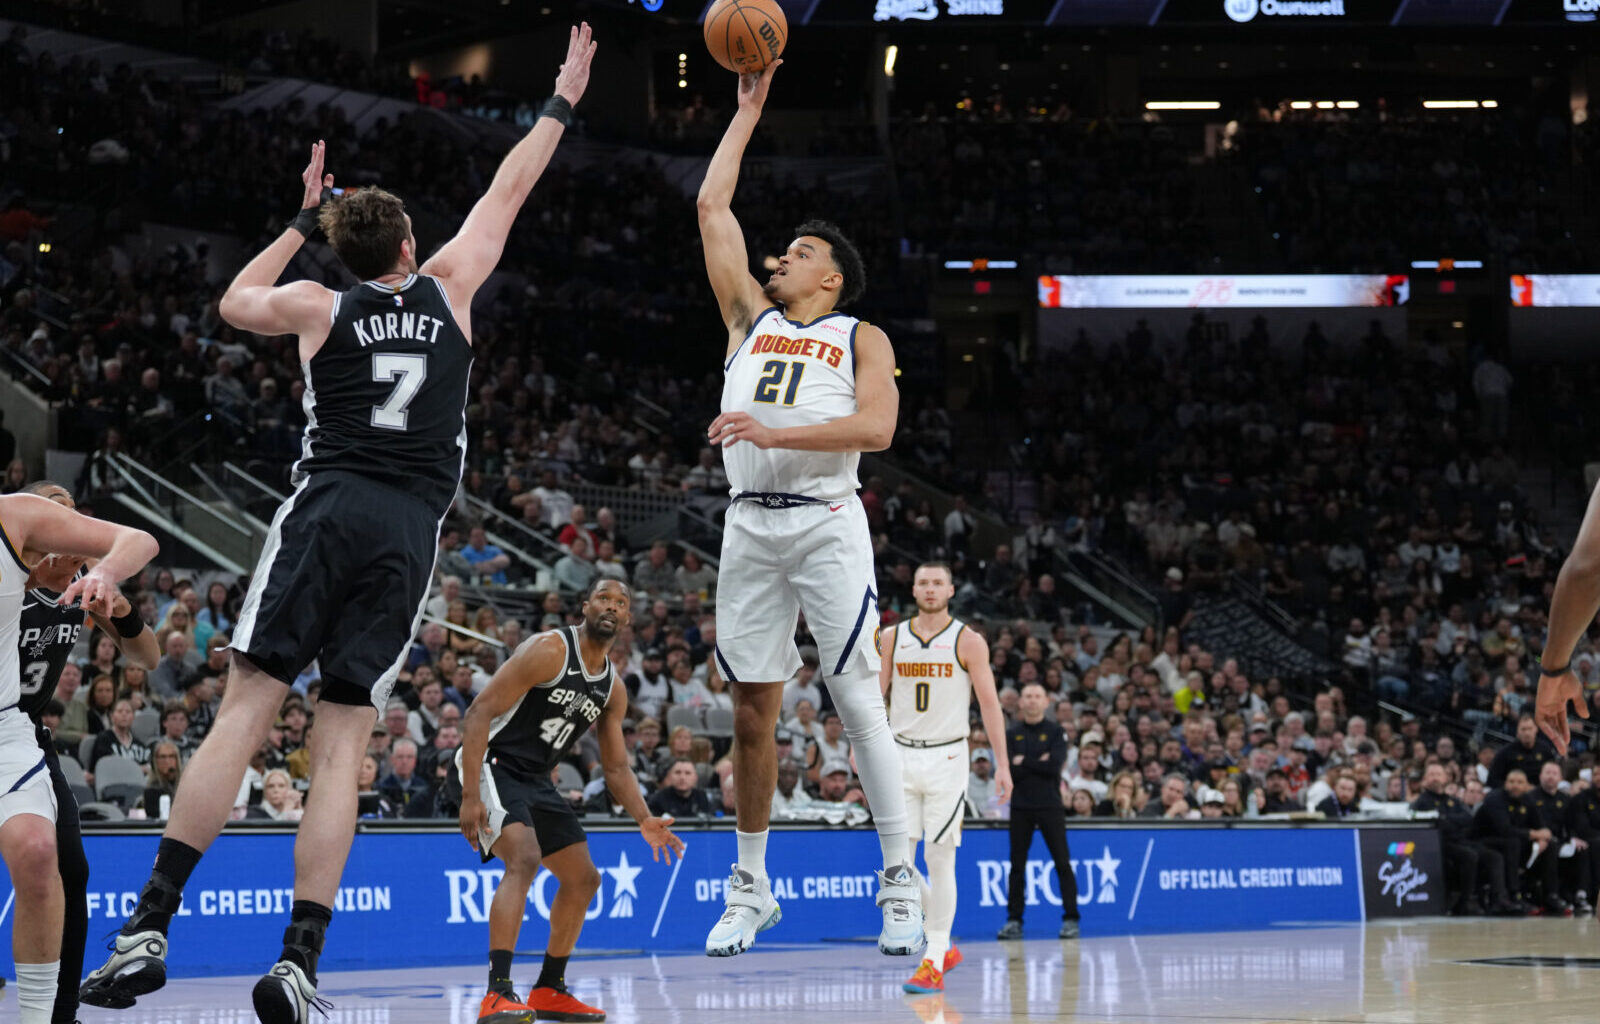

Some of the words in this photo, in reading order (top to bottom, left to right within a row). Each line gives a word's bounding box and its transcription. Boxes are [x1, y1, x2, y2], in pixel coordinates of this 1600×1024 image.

[352, 312, 444, 347] KORNET
[750, 334, 845, 369] NUGGETS
[370, 351, 428, 431] 7
[752, 359, 807, 407] 21
[896, 662, 953, 678] NUGGETS
[547, 687, 602, 723] SPURS
[915, 681, 930, 713] 0
[540, 716, 577, 750] 40
[803, 875, 875, 900] CREDIT
[1158, 869, 1238, 891] OFFICIAL
[1239, 867, 1294, 889] CREDIT
[1296, 866, 1343, 887] UNION
